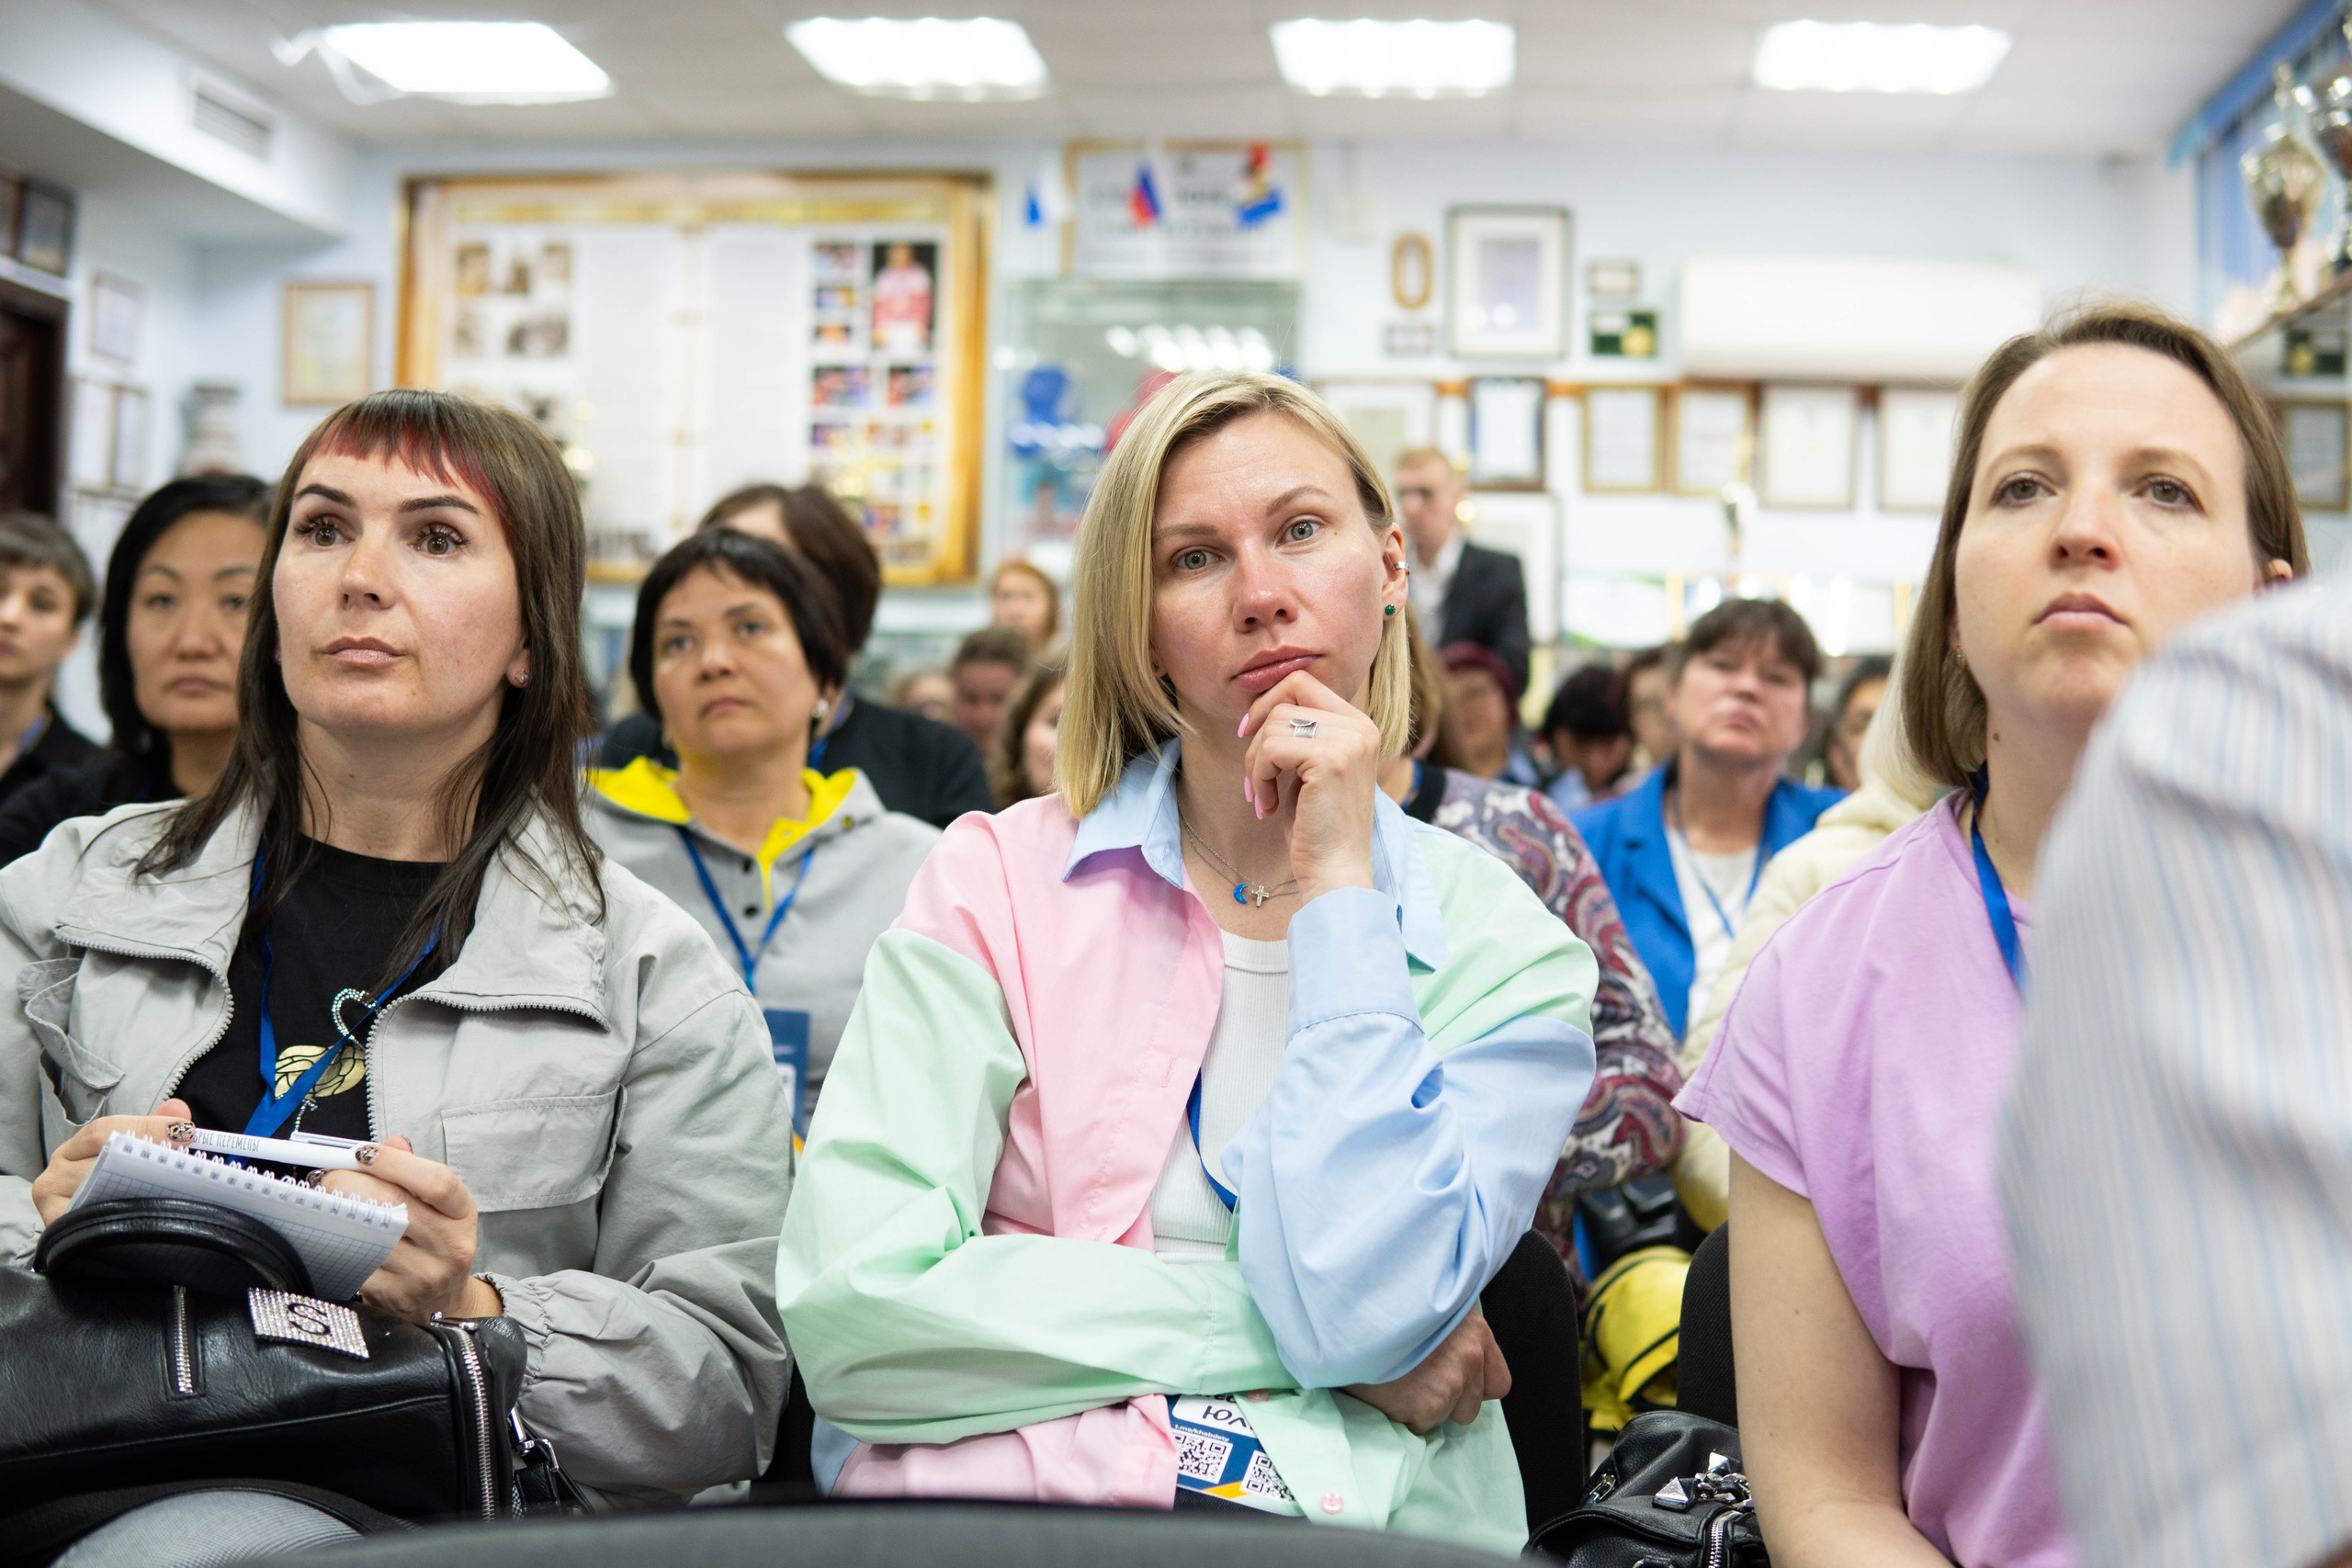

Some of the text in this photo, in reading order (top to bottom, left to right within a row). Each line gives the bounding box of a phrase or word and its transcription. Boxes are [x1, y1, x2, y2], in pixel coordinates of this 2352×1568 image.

[216, 1134, 260, 1152] ПЕРЕМЕНЫ
[288, 1303, 331, 1336] S
[1202, 1405, 1253, 1431] ЮЛ
